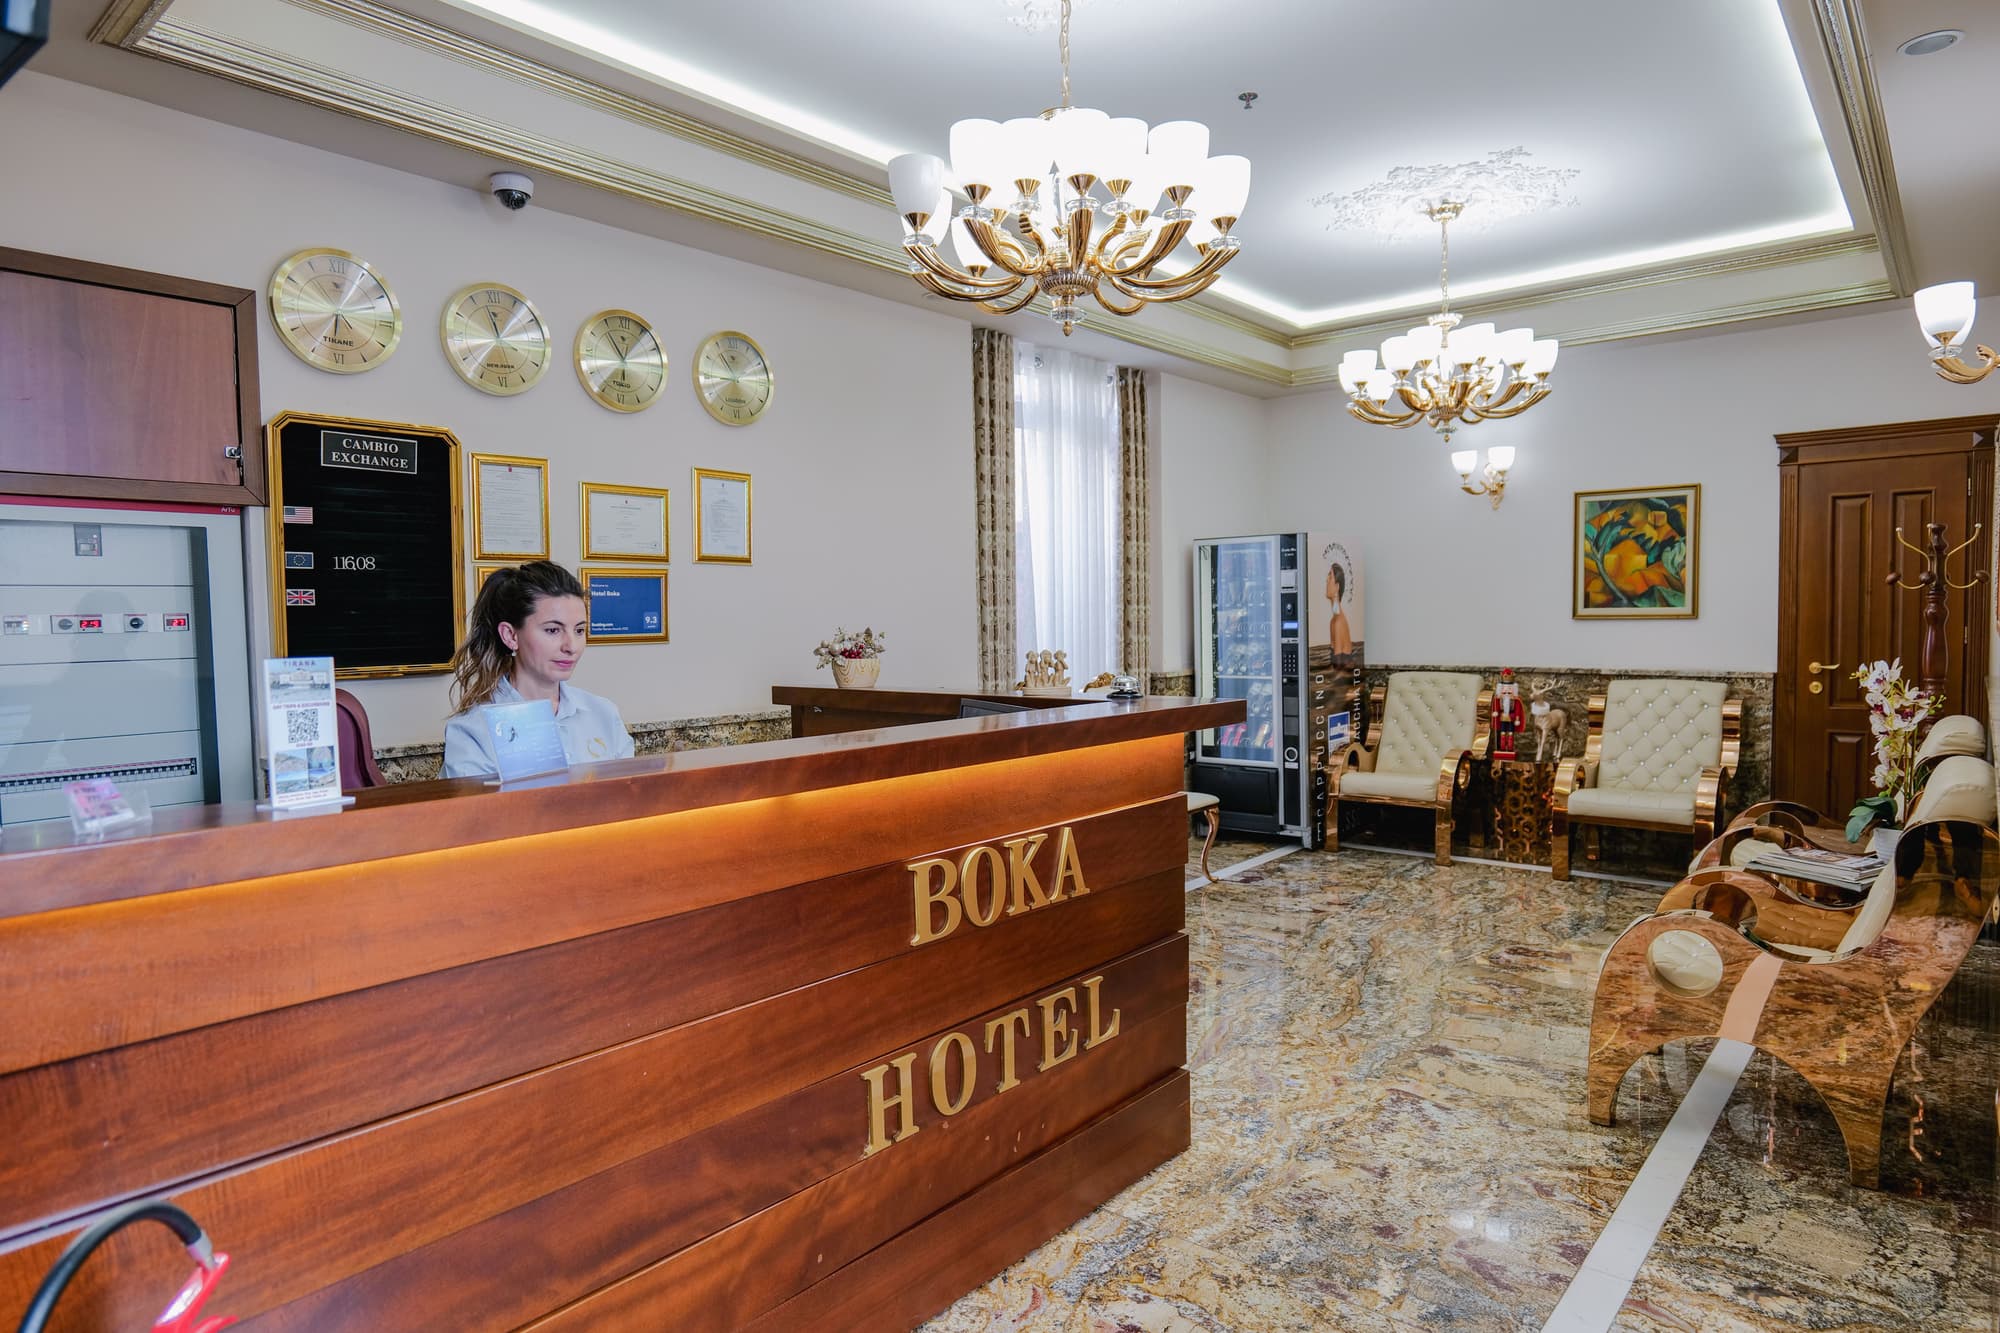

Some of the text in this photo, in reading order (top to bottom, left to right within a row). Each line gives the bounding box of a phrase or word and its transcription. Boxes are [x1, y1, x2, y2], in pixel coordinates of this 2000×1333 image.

[332, 451, 409, 469] EXCHANGE
[342, 438, 399, 454] CAMBIO
[1315, 674, 1325, 817] CAPPUCCINO
[905, 826, 1091, 947] BOKA
[860, 975, 1121, 1160] HOTEL
